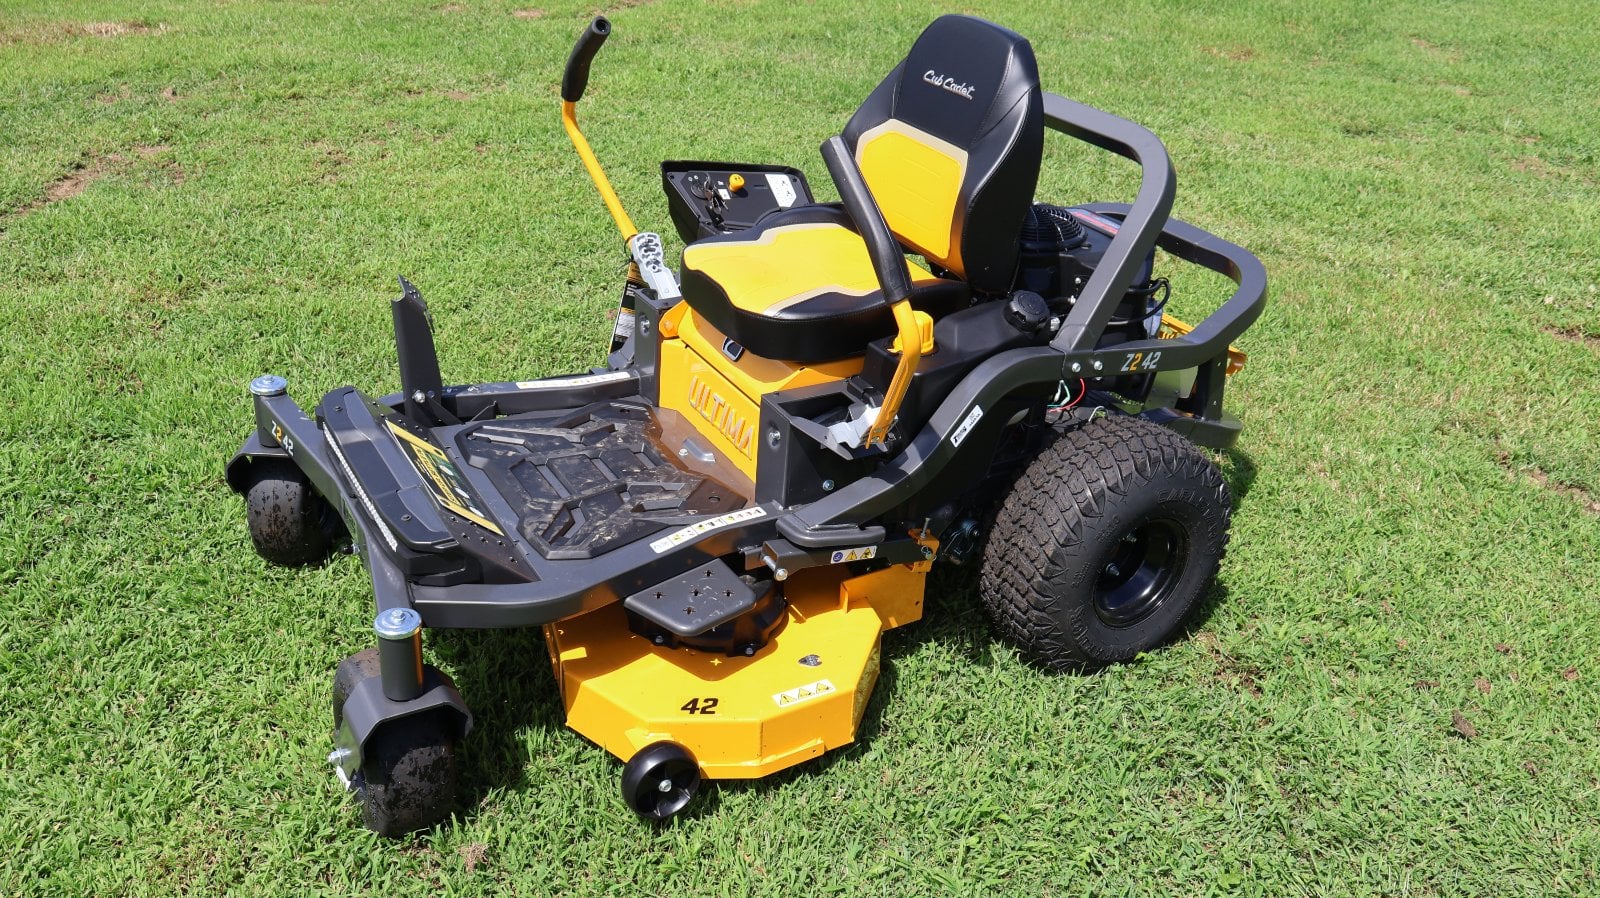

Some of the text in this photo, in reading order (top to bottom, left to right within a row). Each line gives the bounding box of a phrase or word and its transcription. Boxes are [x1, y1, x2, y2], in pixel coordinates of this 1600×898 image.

[923, 70, 976, 100] Cub Cadet
[688, 374, 754, 461] ULTIMA
[680, 697, 719, 715] 42
